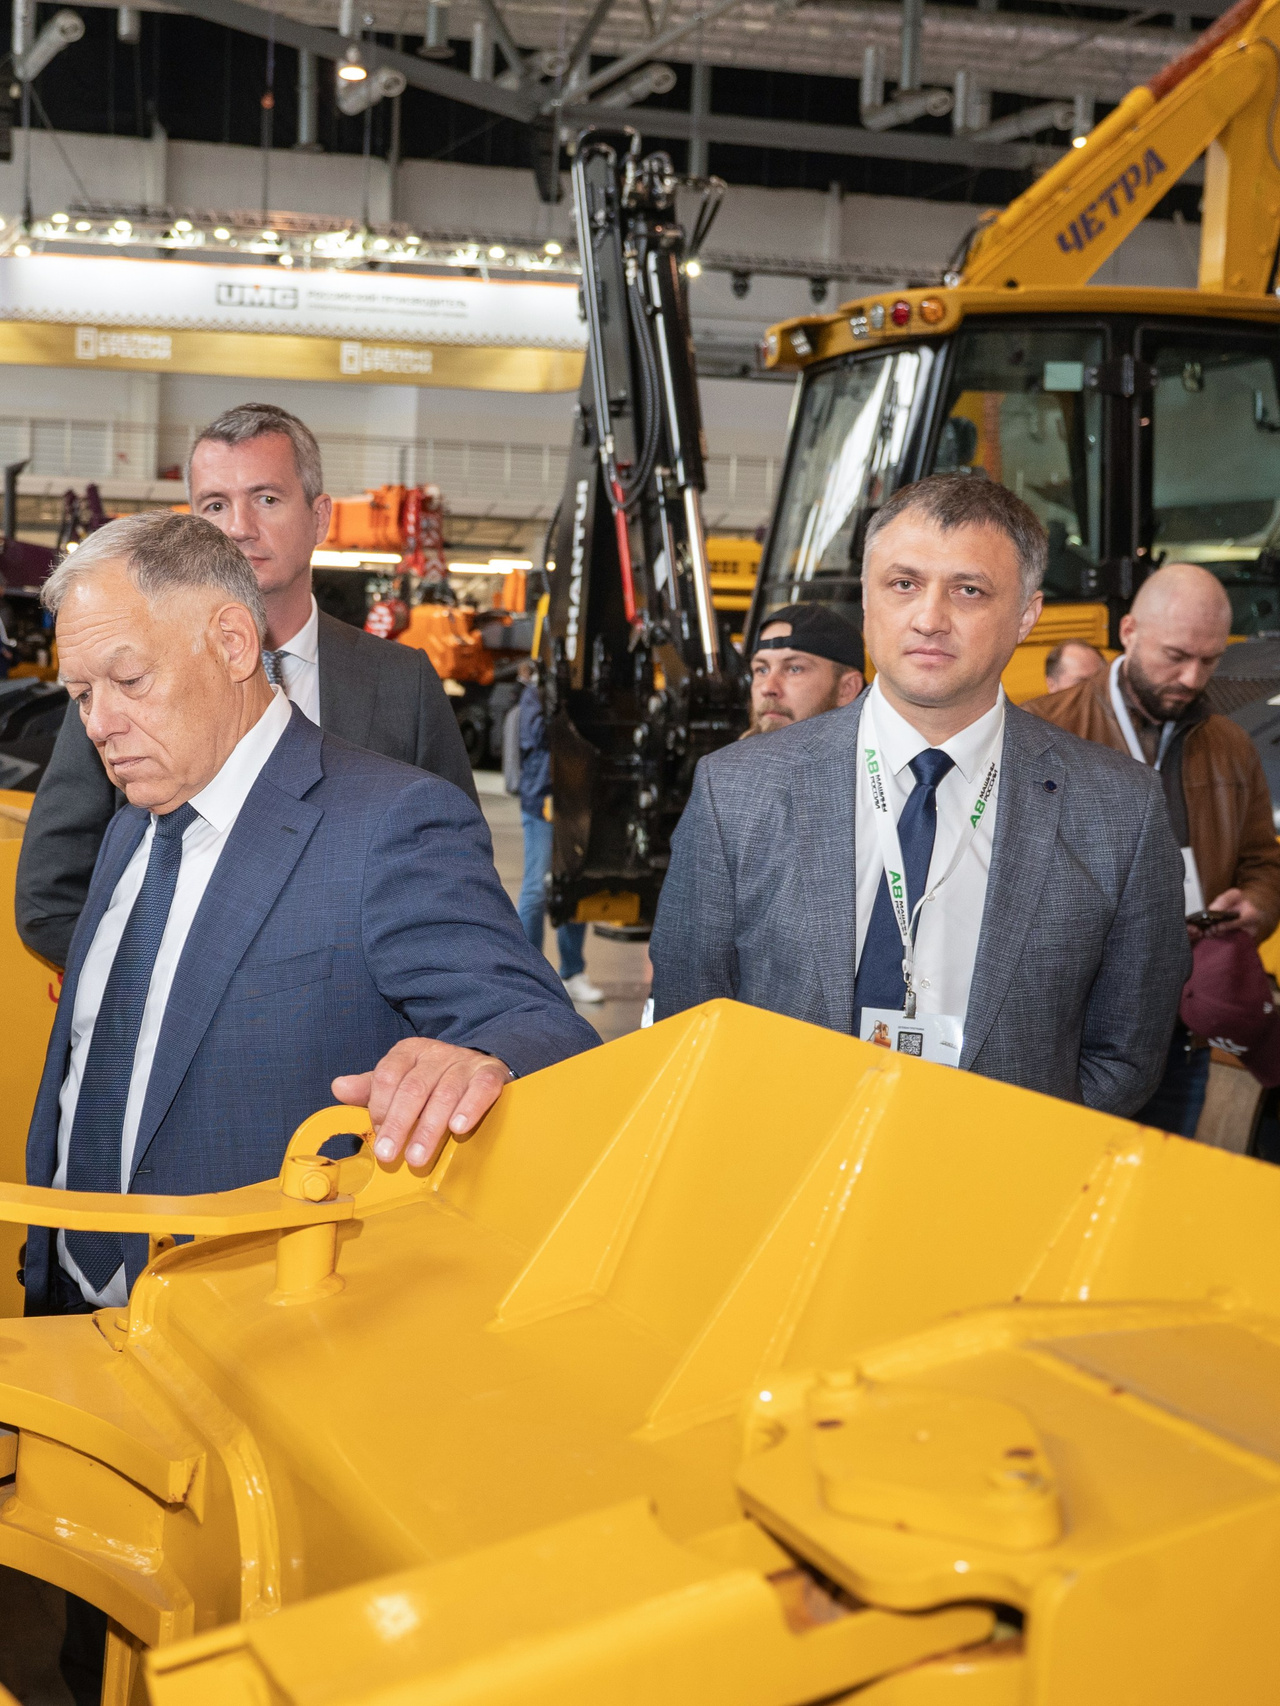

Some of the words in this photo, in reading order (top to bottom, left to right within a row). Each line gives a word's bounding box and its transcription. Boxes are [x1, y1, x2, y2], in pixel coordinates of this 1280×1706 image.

[1057, 148, 1166, 252] ЧЕТРА
[870, 776, 881, 809] РОССИИ
[984, 769, 998, 802] РОССИИ
